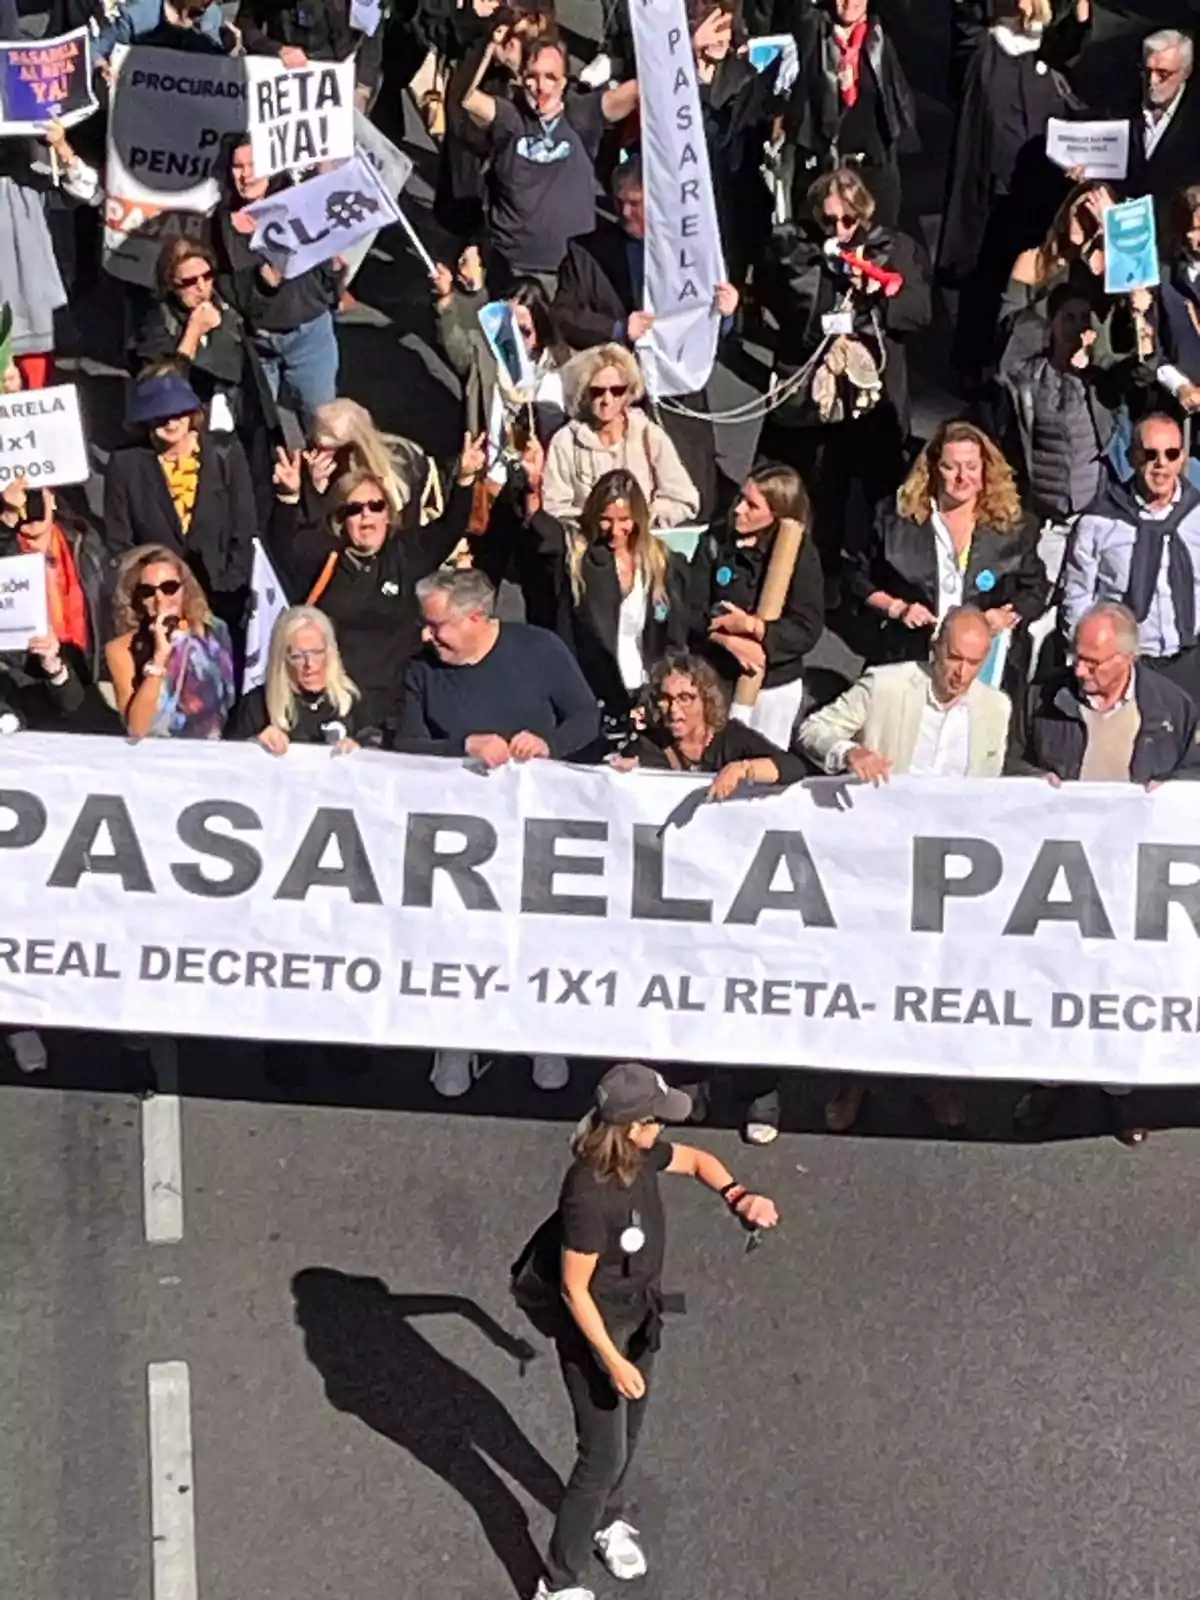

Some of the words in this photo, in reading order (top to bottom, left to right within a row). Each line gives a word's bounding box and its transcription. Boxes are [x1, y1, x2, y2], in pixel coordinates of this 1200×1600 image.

[256, 69, 343, 124] RETA
[268, 115, 329, 170] ¡YA!
[911, 835, 1200, 942] PAR
[138, 945, 382, 993] DECRETO
[399, 959, 510, 1000] LEY-
[527, 967, 618, 1007] 1X1
[637, 973, 706, 1011] AL
[723, 977, 876, 1020] RETA-
[893, 985, 1033, 1027] REAL
[1051, 991, 1200, 1034] DECR
